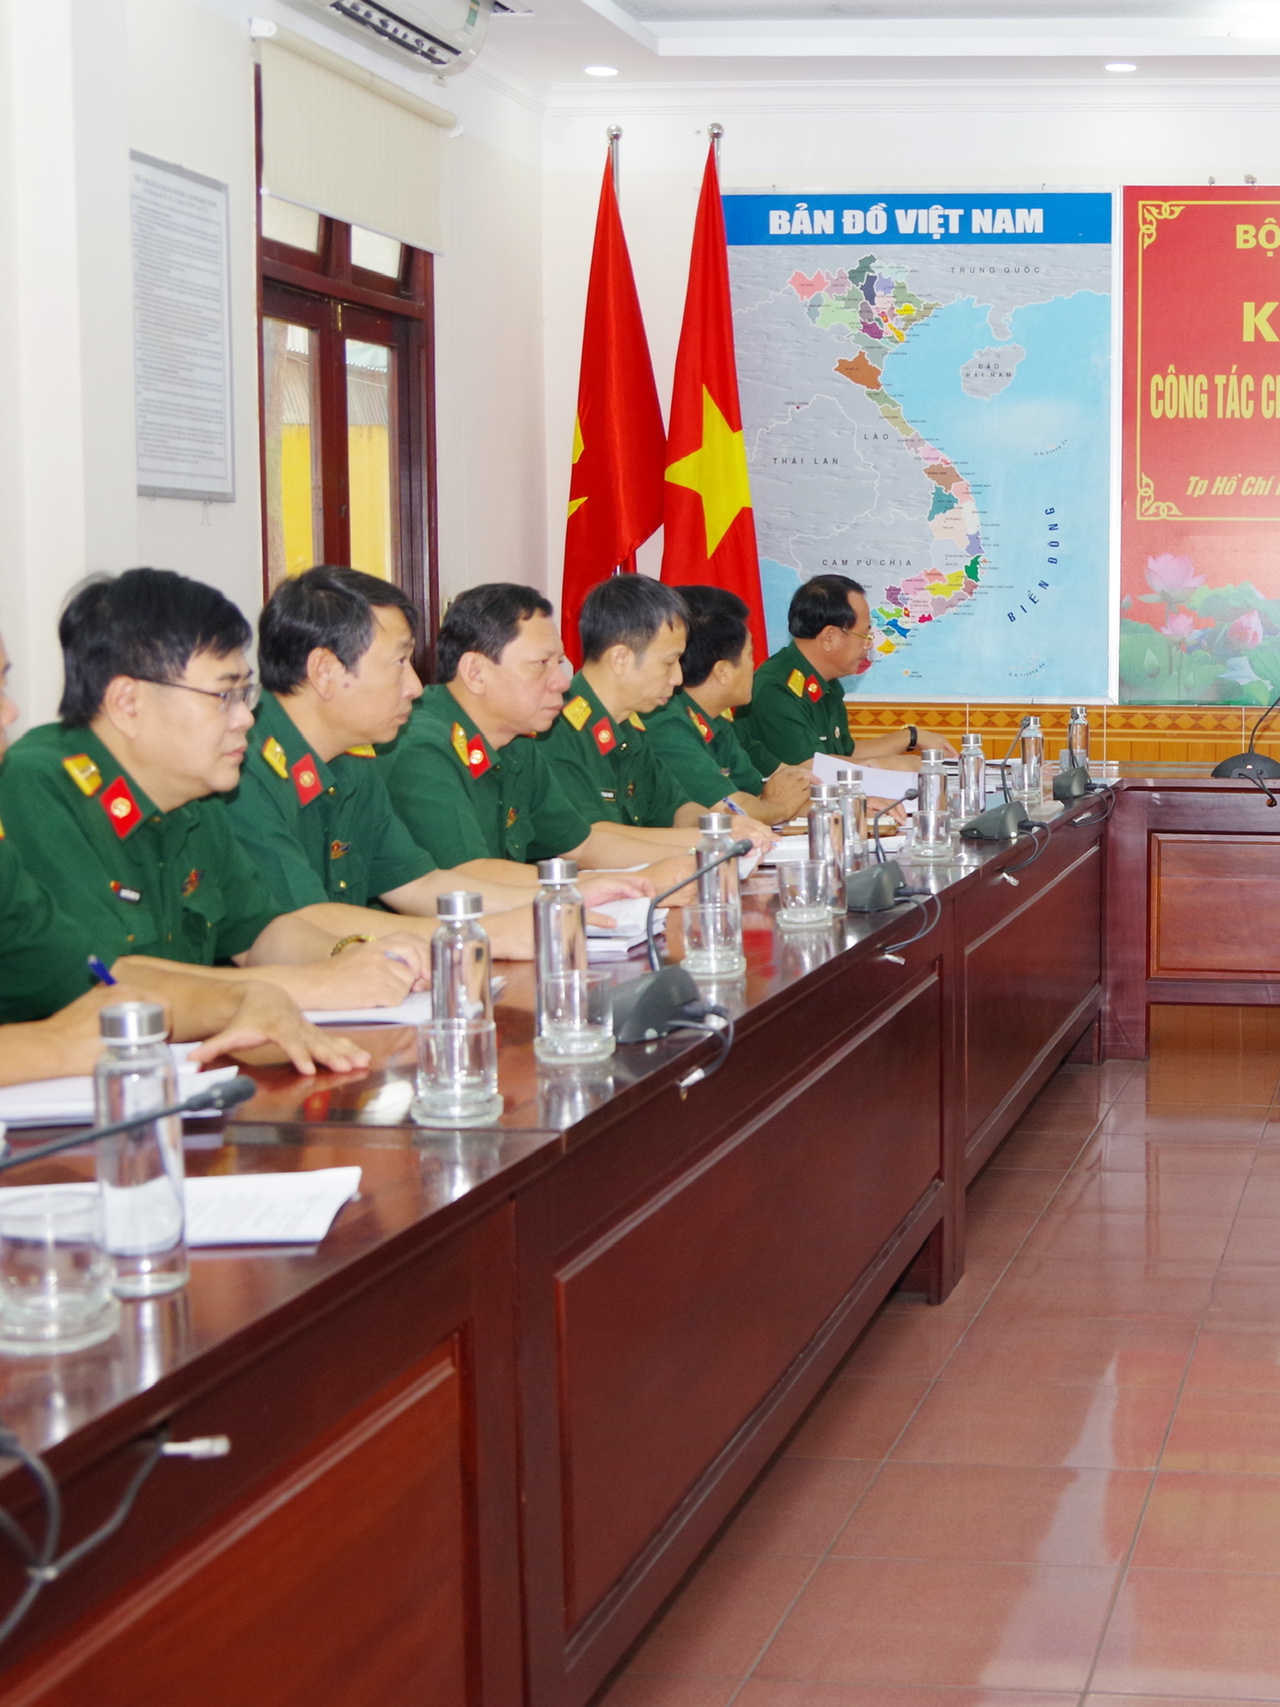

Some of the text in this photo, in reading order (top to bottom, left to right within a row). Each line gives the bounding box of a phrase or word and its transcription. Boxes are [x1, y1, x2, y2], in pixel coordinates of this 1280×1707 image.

[769, 203, 1044, 240] BẢN ĐỒ VIỆT NAM
[1150, 364, 1209, 420] CÔNG
[1214, 364, 1255, 420] TÁC
[773, 456, 839, 465] THÁI LAN
[1186, 476, 1209, 498] Tp
[1211, 473, 1243, 496] Hồ
[1240, 475, 1276, 496] Chí
